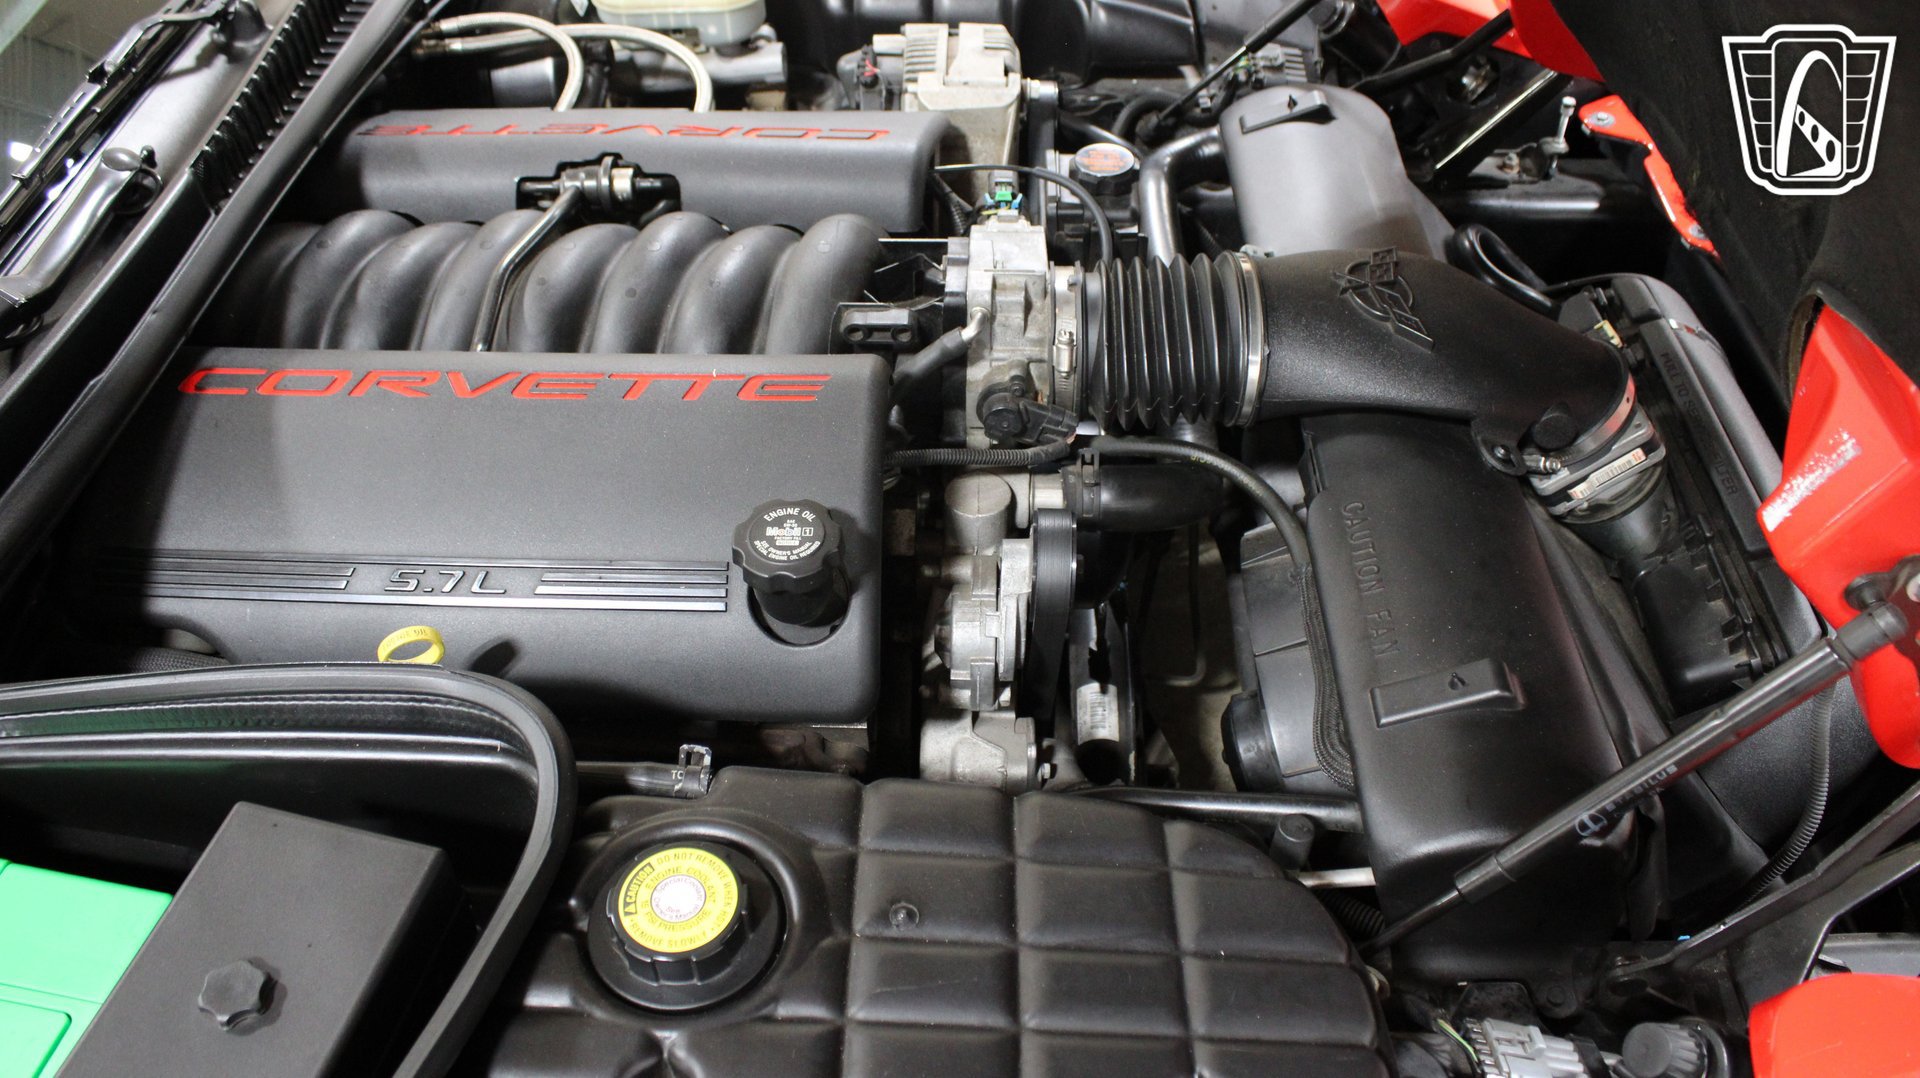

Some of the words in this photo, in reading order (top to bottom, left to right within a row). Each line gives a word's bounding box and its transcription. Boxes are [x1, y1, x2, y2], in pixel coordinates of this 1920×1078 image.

[356, 123, 890, 140] CORVETTE
[177, 368, 832, 401] CORVETTE
[763, 507, 801, 522] ENGINE
[801, 510, 816, 522] OIL
[765, 526, 801, 536] Mobil
[792, 542, 813, 554] MANUAL
[384, 569, 508, 594] 5.7L
[1342, 501, 1386, 595] CAUTION
[1366, 609, 1400, 657] FAN
[656, 855, 671, 865] DO
[673, 852, 693, 860] NOT
[695, 855, 729, 881] REMOVE
[625, 862, 654, 903] CAUTION
[645, 866, 683, 890] ENGINE
[686, 867, 717, 904] COOLANT
[629, 922, 664, 948] REMOVE
